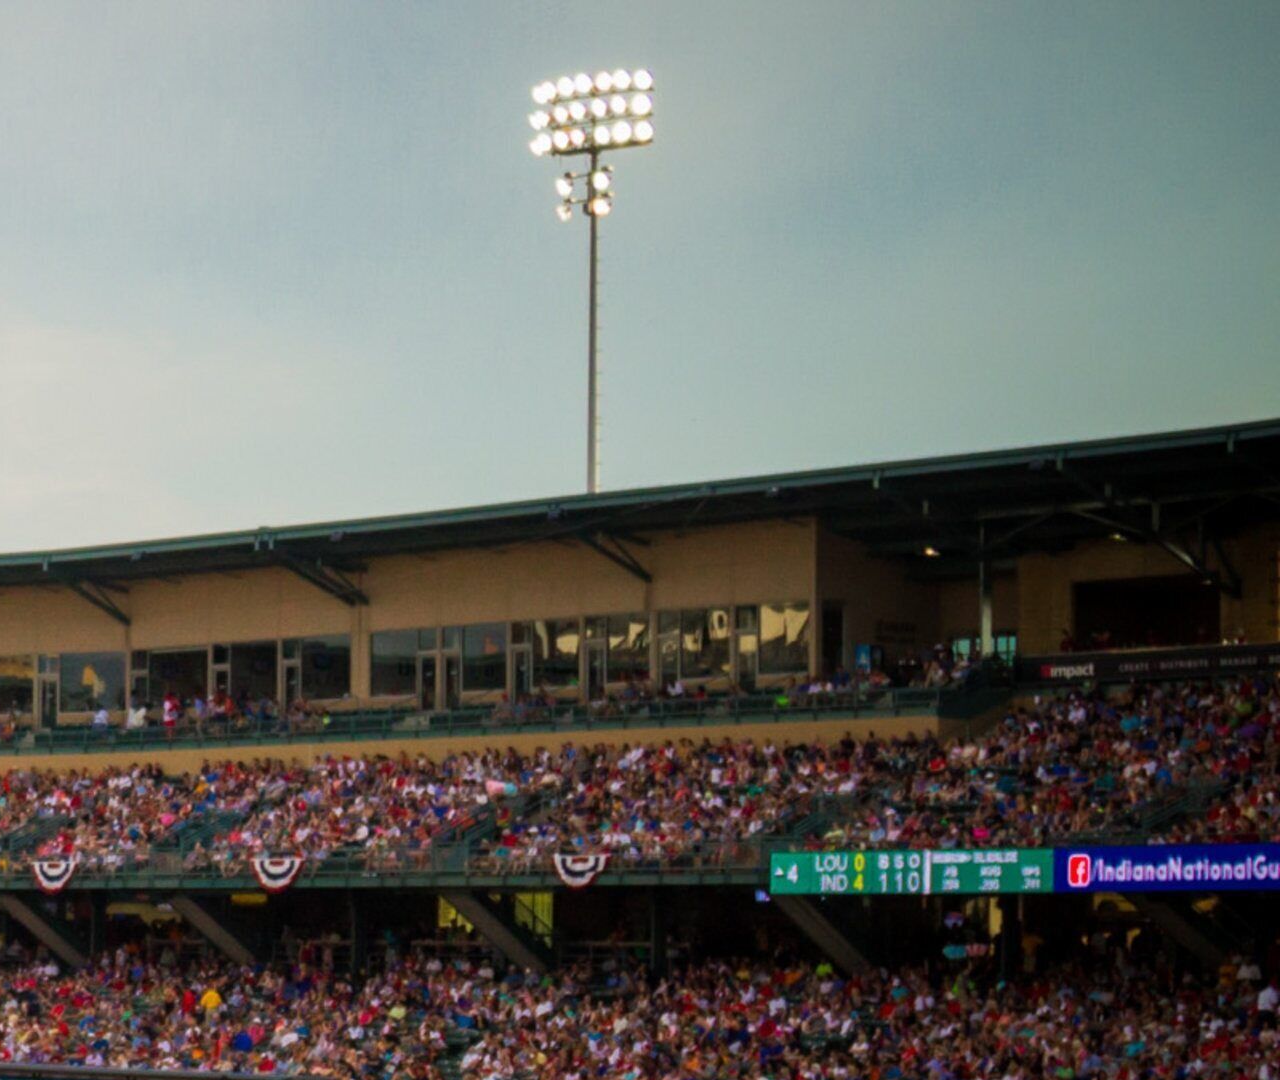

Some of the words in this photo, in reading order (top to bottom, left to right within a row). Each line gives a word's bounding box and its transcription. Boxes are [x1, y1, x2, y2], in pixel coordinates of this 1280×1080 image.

[815, 855, 849, 872] LOU
[853, 853, 865, 872] 0
[786, 863, 799, 884] 4
[821, 874, 849, 892] IND
[853, 873, 865, 891] 4
[879, 871, 888, 892] 1
[894, 871, 903, 892] 1
